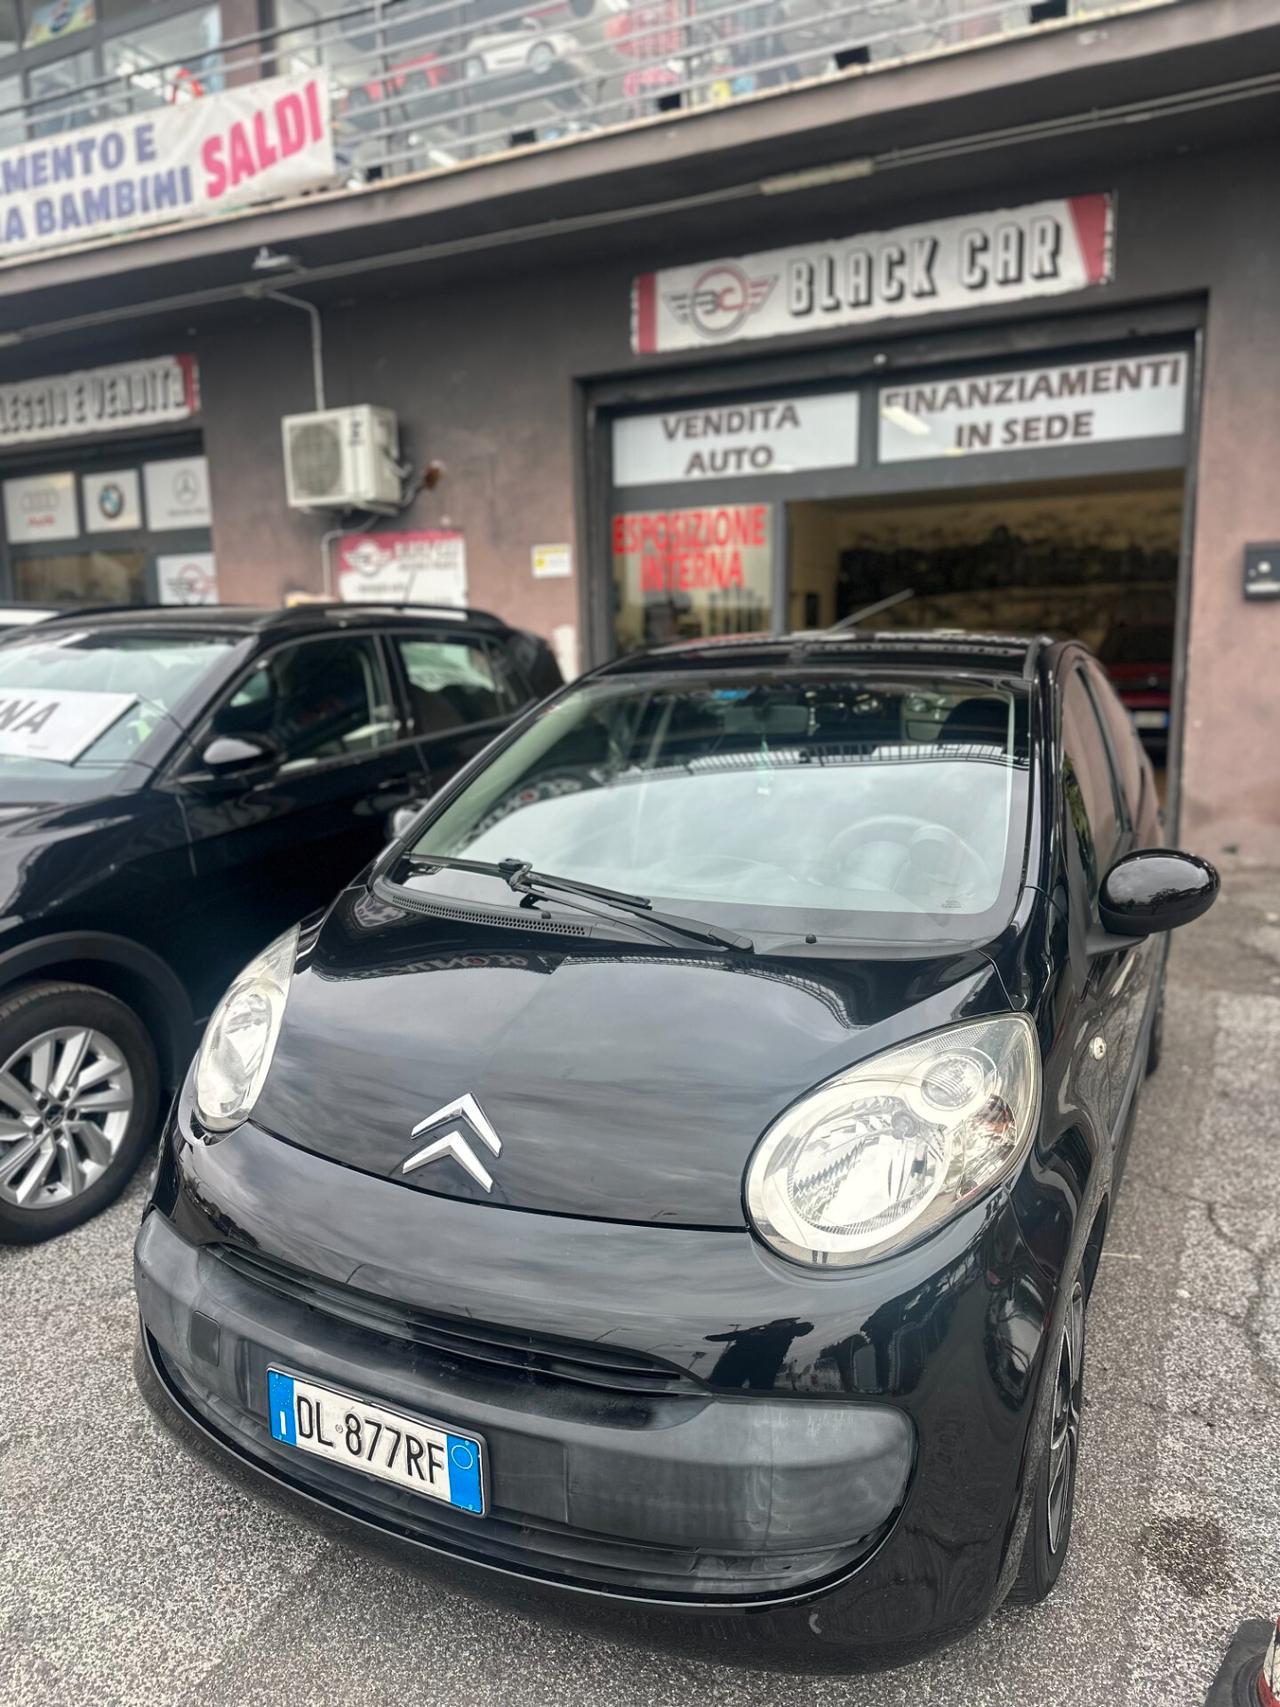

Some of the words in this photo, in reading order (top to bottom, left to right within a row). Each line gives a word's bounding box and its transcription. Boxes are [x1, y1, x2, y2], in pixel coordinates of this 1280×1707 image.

[0, 141, 125, 195] MENTO
[135, 124, 156, 164] E
[201, 81, 323, 198] SALDI
[0, 206, 26, 243] A
[36, 165, 193, 236] BAMBINI
[788, 236, 938, 317] BLACK
[960, 215, 1061, 289] CAR
[885, 358, 1181, 414] FINANZIAMENTI
[661, 403, 799, 440] VENDITA
[956, 423, 993, 448] IN
[1002, 412, 1095, 446] SEDE
[685, 444, 774, 475] AUTO
[613, 505, 767, 553] ESPOSIZIONE
[642, 551, 744, 591] INTERNA
[0, 699, 60, 734] NA
[296, 1395, 335, 1448] DL
[344, 1413, 445, 1485] 877RF
